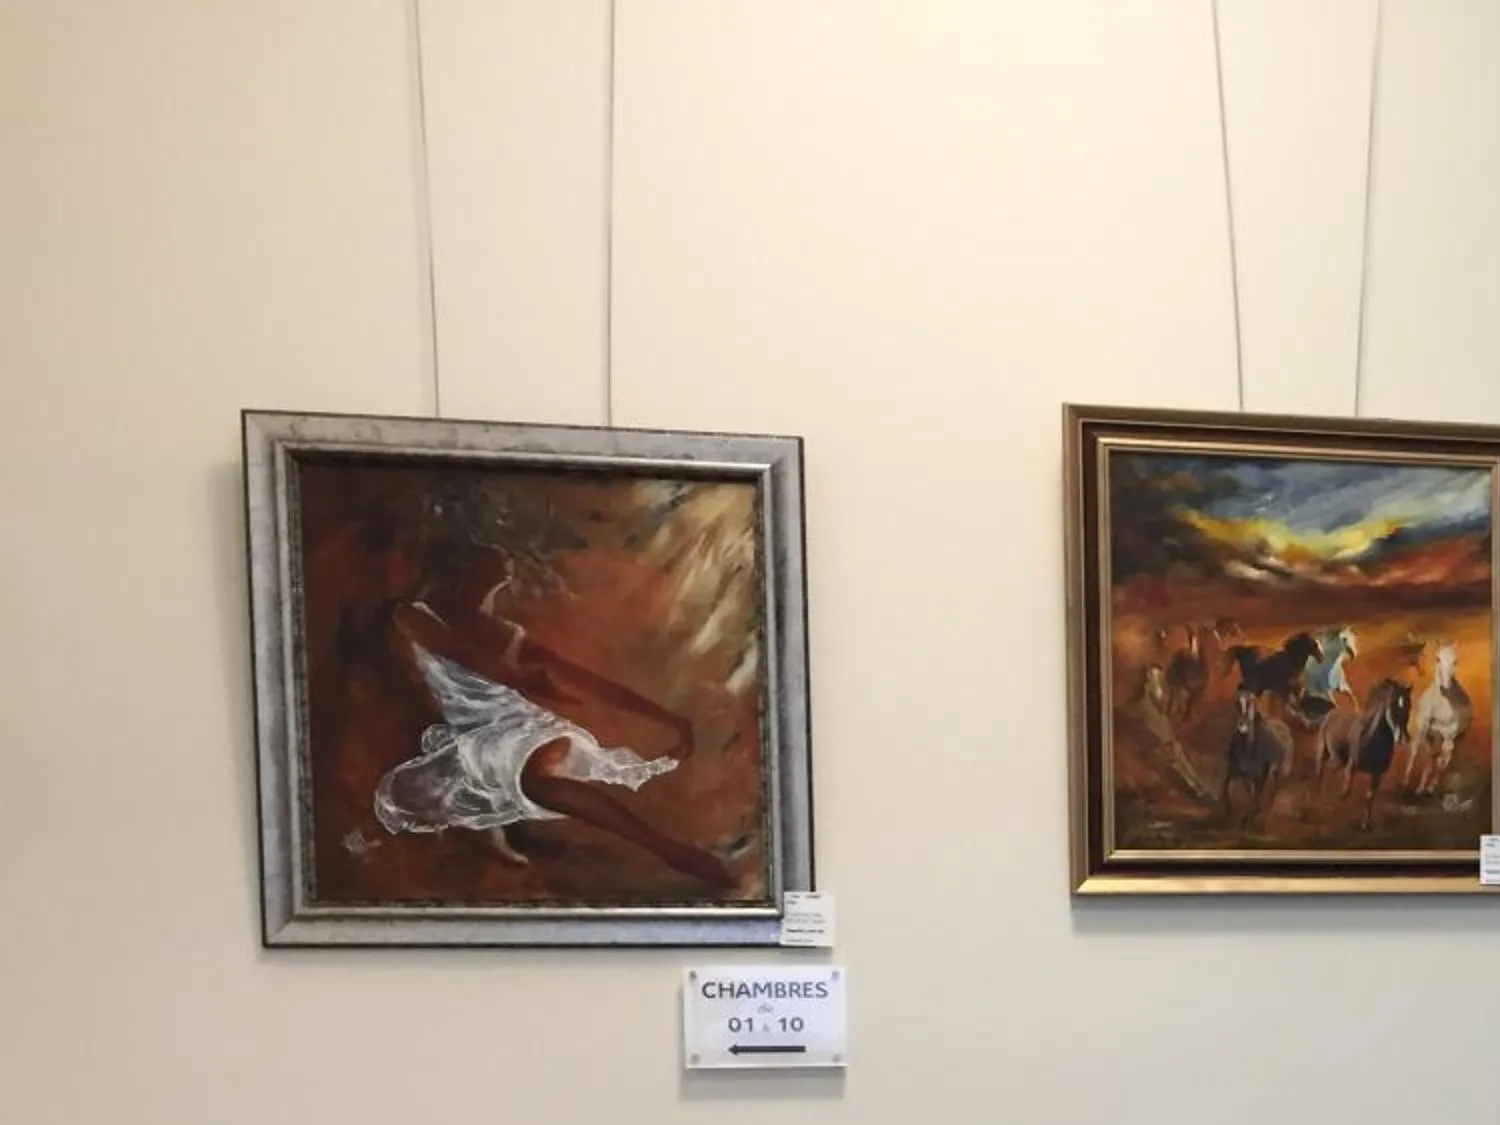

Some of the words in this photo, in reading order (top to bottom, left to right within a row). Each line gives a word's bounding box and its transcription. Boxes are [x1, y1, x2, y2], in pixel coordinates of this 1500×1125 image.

[701, 981, 829, 999] CHAMBRES
[727, 1017, 753, 1032] 01
[777, 1017, 804, 1032] 10
